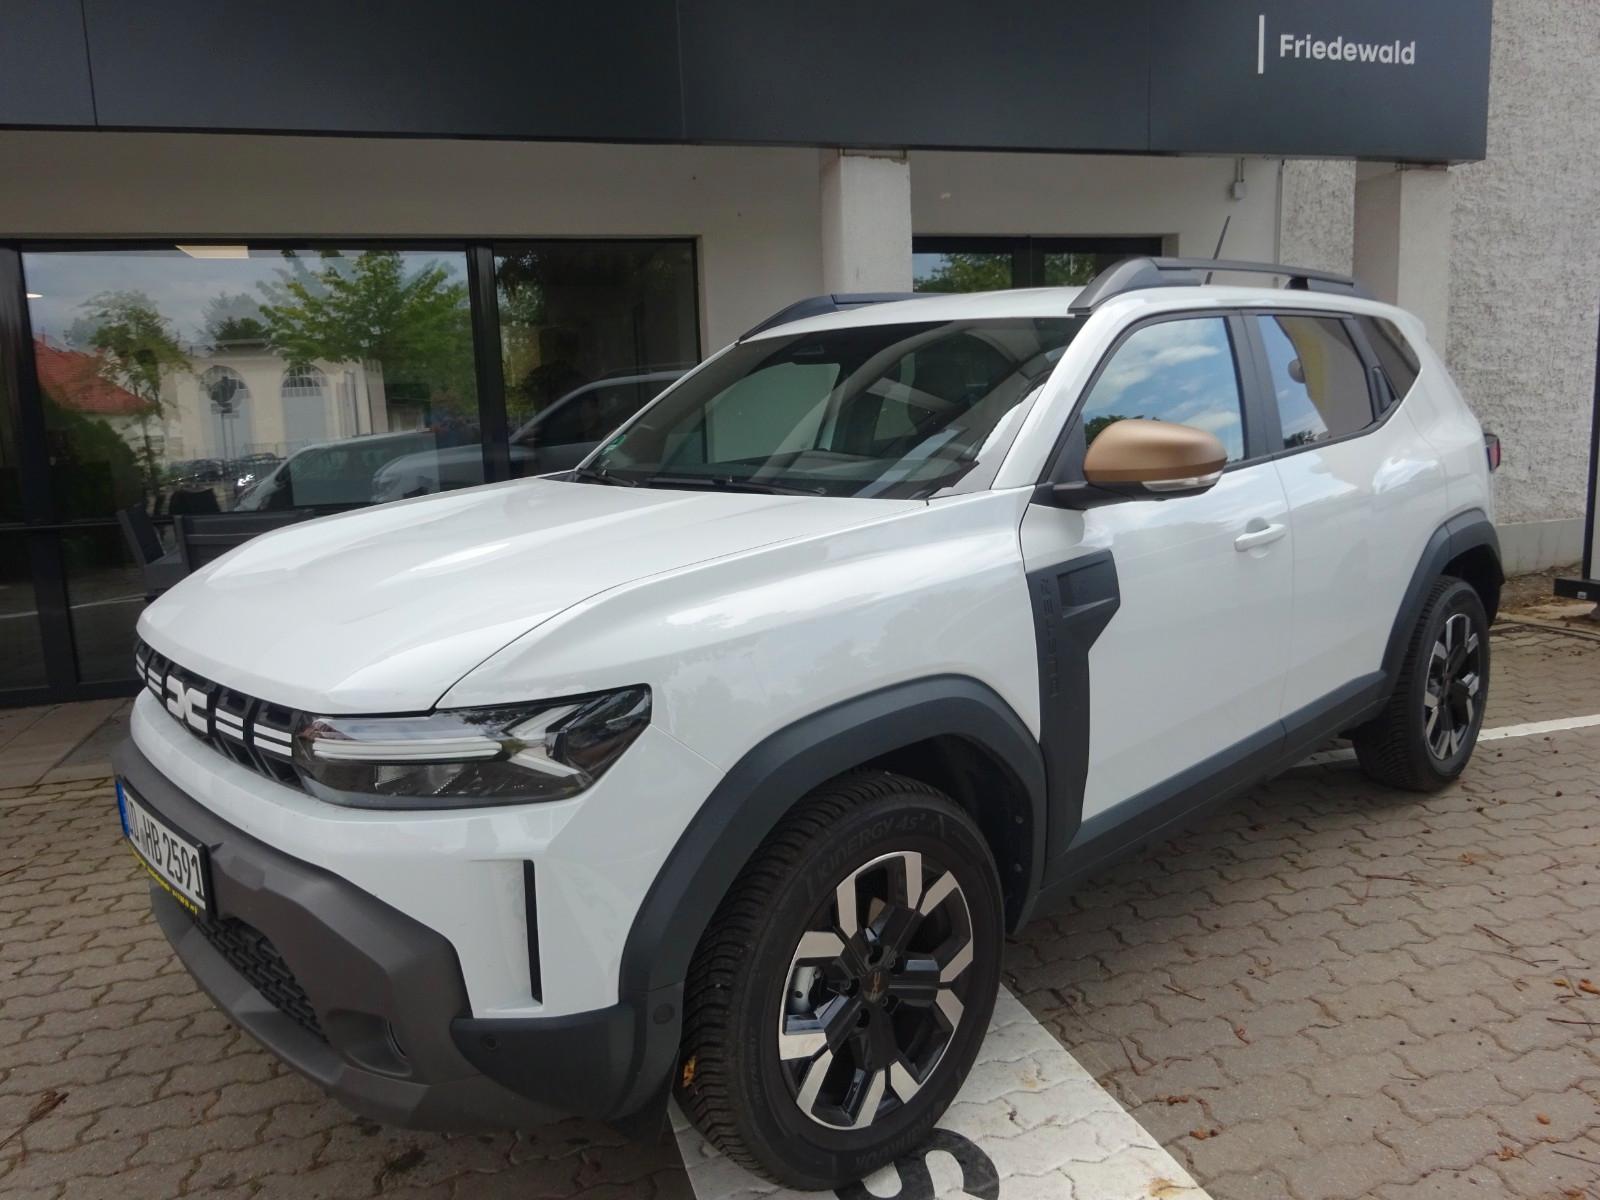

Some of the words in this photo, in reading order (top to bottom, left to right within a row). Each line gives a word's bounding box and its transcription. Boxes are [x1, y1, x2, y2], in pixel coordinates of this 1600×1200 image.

[1280, 34, 1415, 65] Friedewald
[142, 814, 163, 866] HB
[162, 831, 206, 900] 2591
